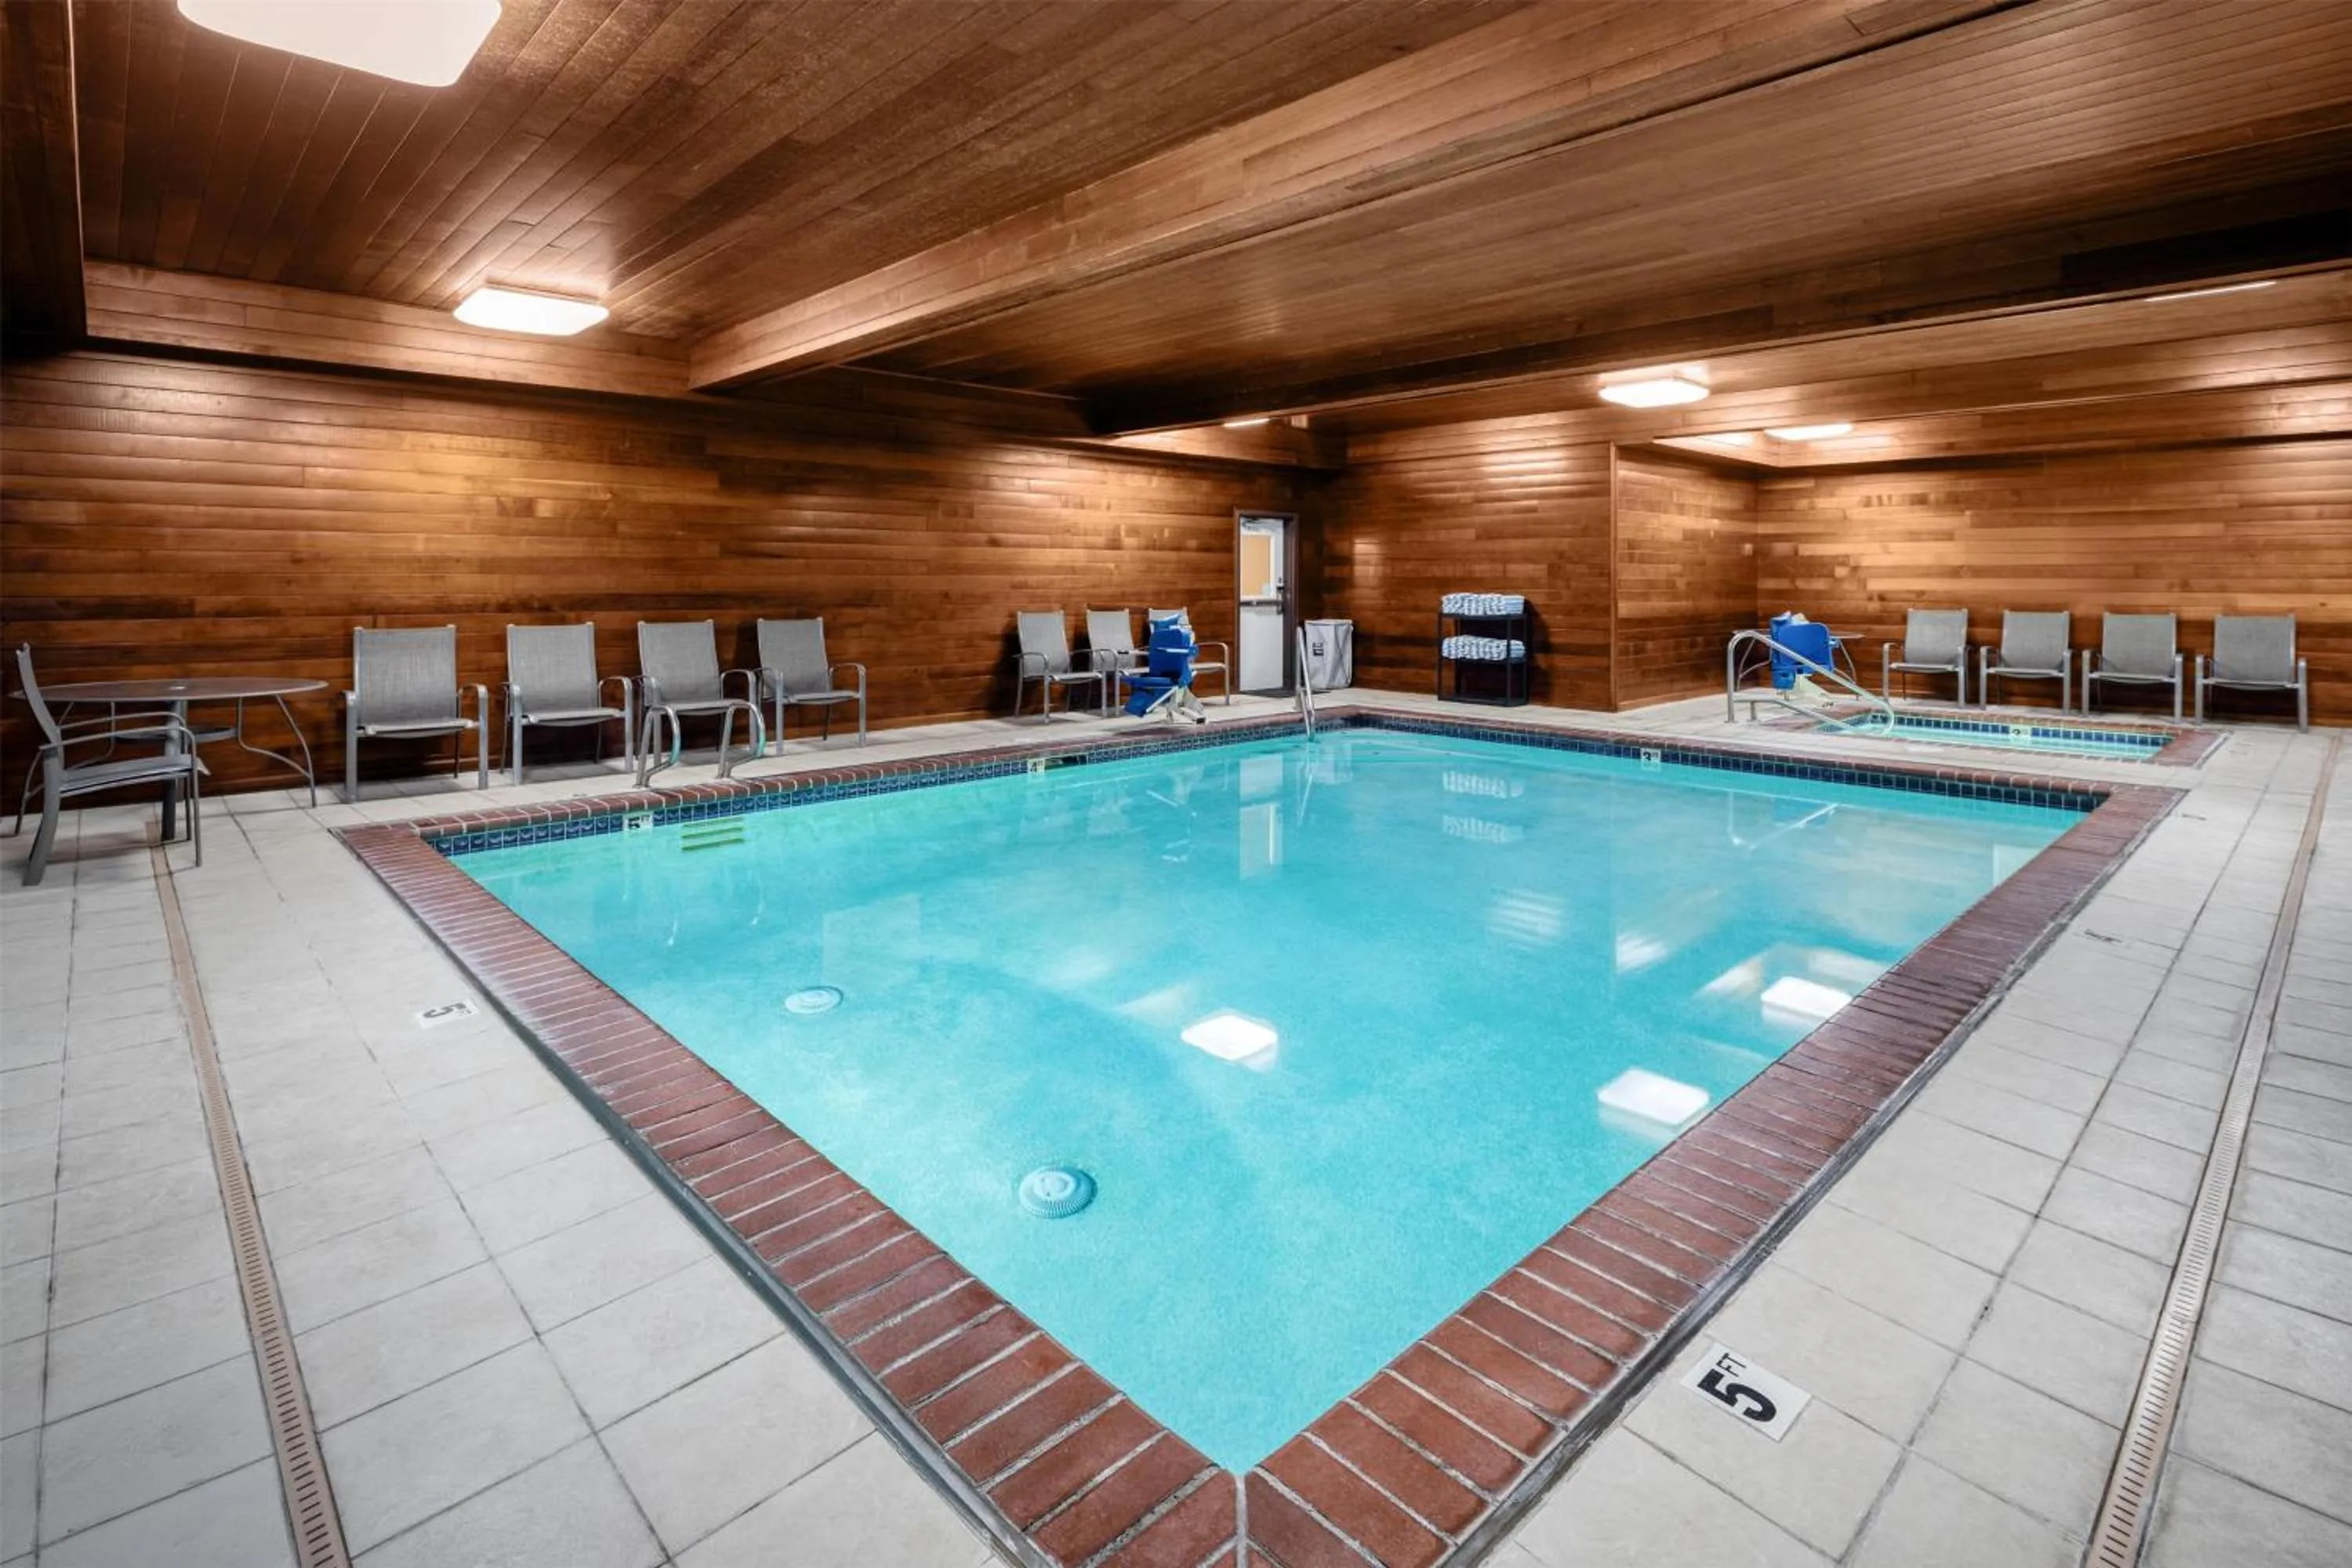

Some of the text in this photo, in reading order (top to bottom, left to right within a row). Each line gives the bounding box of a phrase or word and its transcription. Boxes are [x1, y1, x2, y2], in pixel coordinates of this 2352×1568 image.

[628, 816, 641, 829] 5
[423, 1003, 466, 1018] 5
[1697, 1352, 1777, 1423] 5 FT
